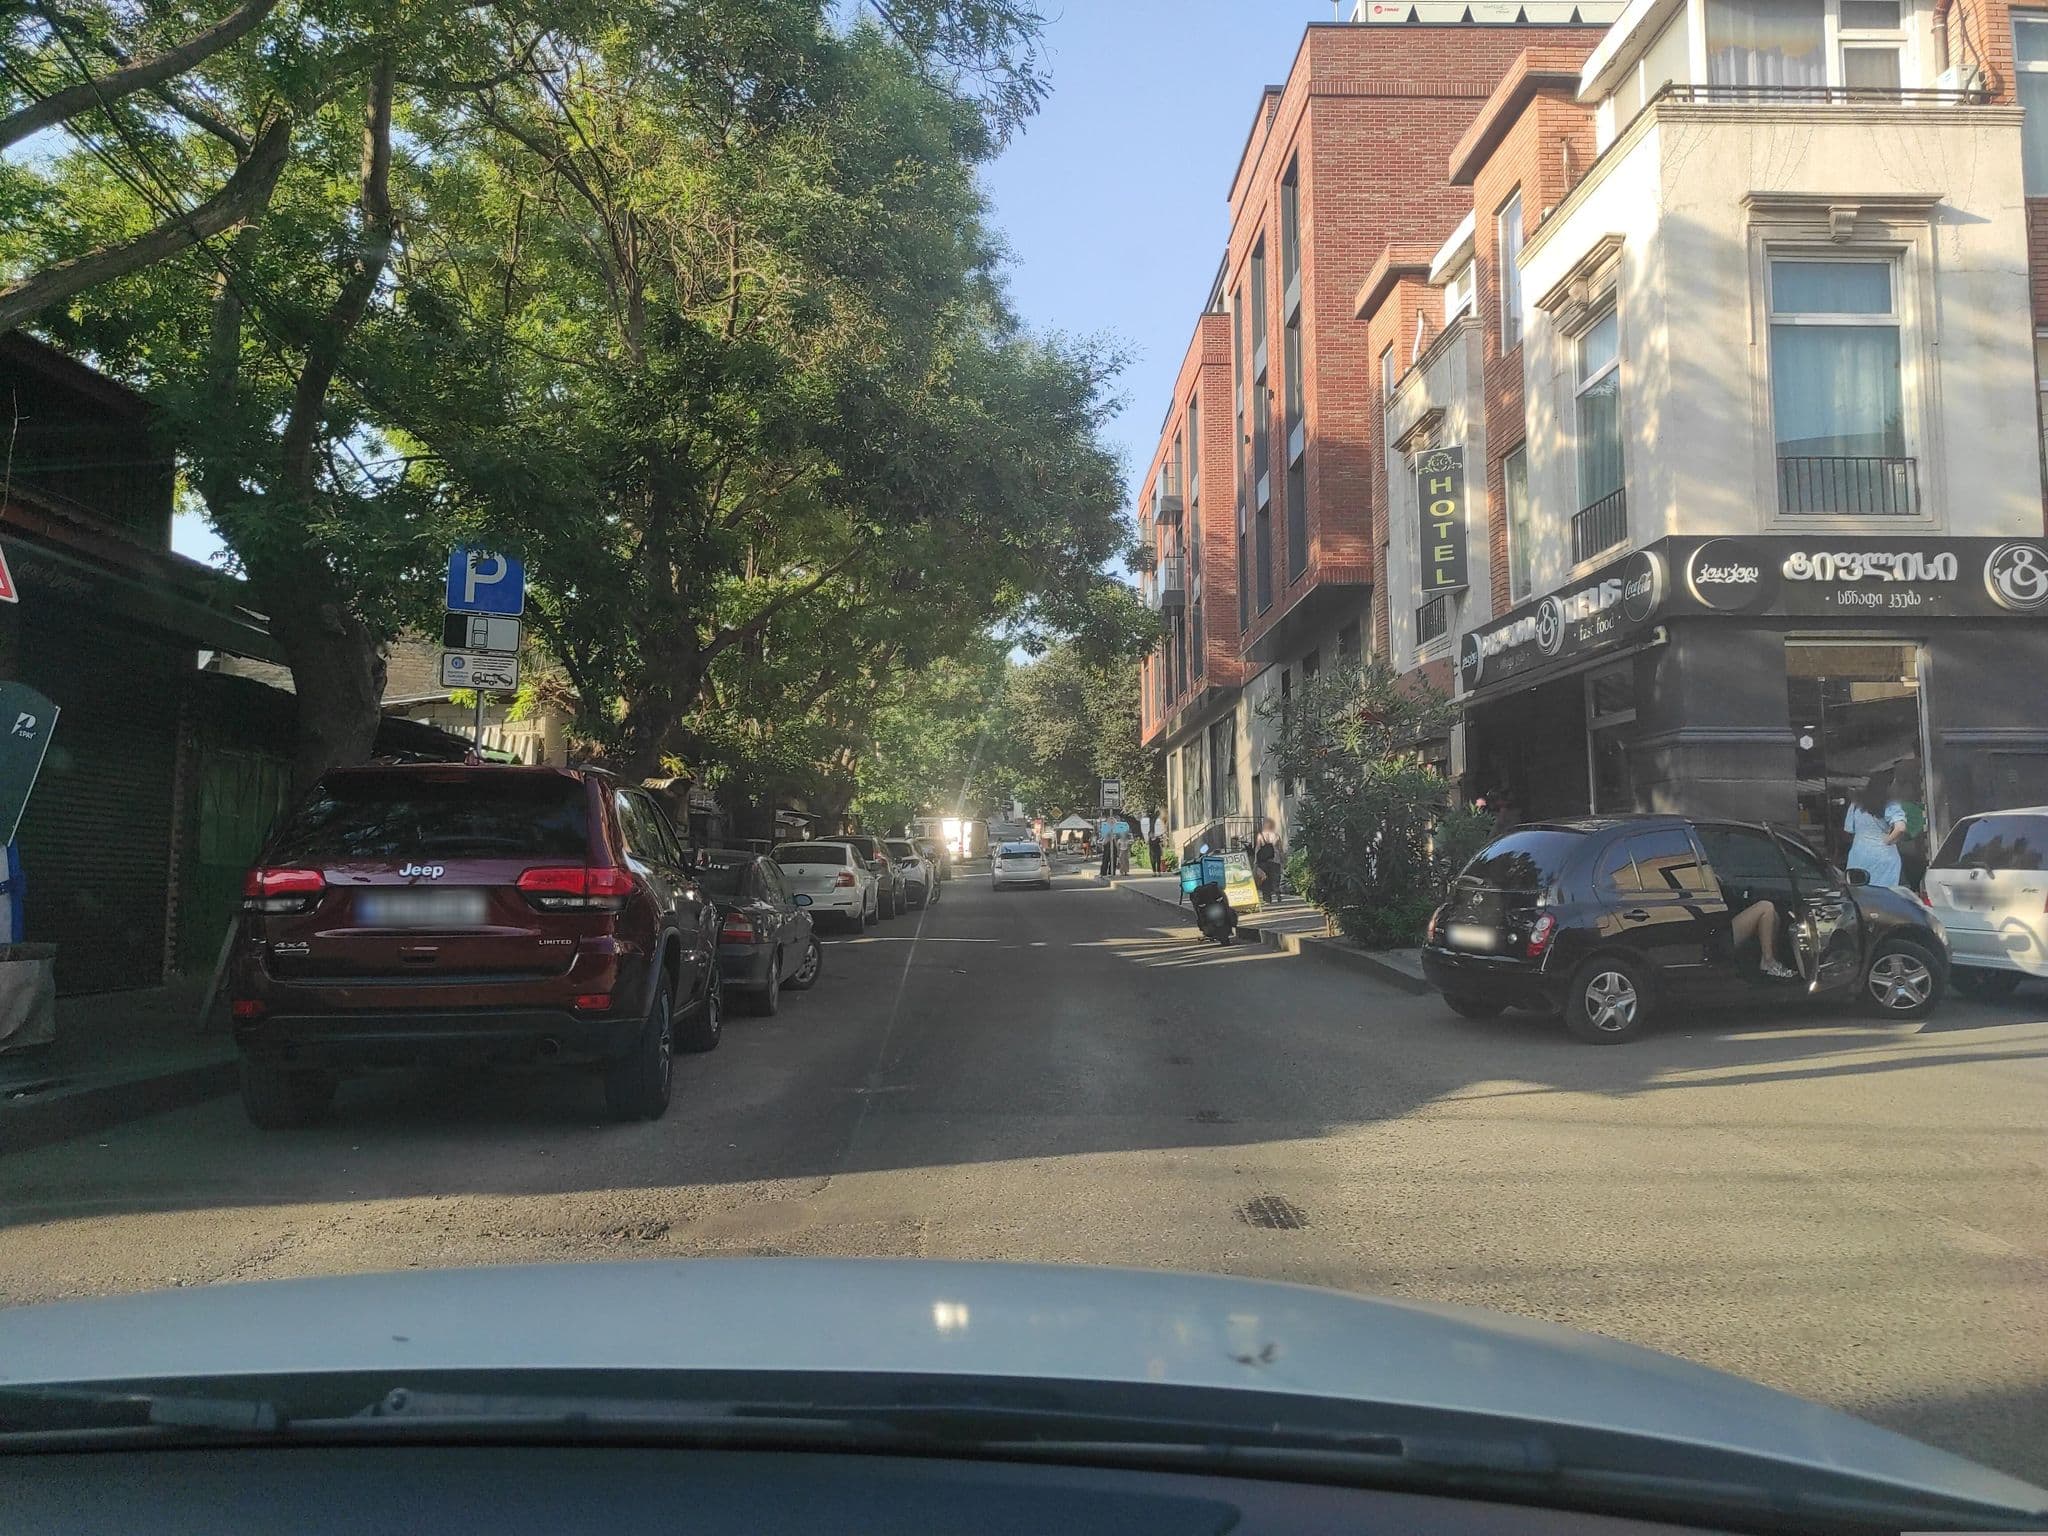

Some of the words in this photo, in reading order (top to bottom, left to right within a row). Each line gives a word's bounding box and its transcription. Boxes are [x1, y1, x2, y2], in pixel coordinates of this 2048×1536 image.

[1429, 475, 1456, 585] HOTEL
[464, 549, 507, 602] P
[1783, 551, 1958, 582] ტიფლისი
[1837, 590, 1882, 608] სწრაფი
[1888, 589, 1922, 608] კვება
[1579, 624, 1594, 641] fast
[1596, 611, 1615, 634] food
[399, 862, 445, 879] Jeep
[274, 941, 309, 949] 4x4
